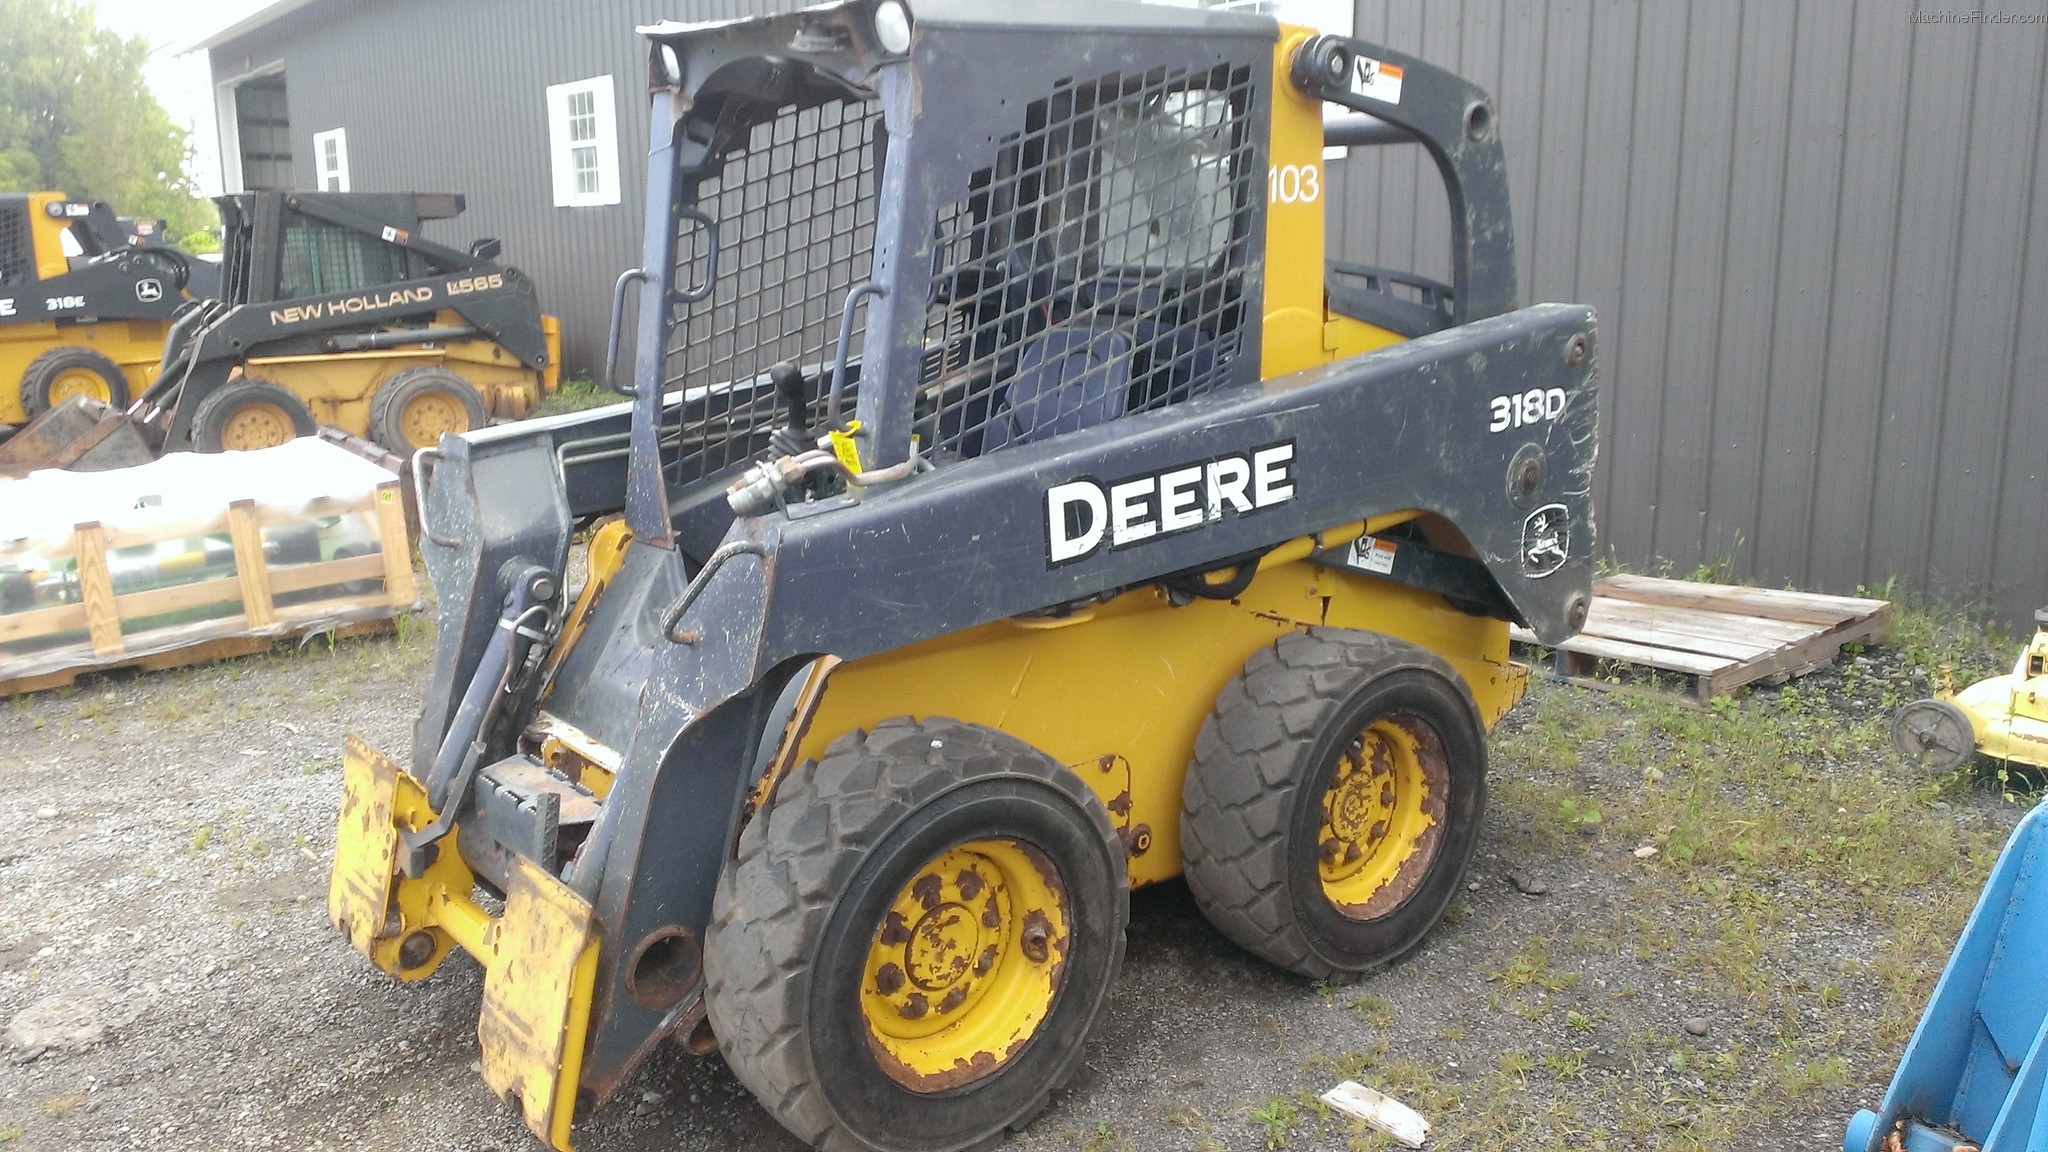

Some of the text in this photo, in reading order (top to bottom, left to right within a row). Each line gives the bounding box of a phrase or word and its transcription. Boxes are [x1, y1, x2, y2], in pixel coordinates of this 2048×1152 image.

[1268, 164, 1320, 204] 103
[270, 302, 322, 326] NEW
[327, 286, 433, 316] HOLLAND
[1489, 387, 1567, 433] 318D
[1047, 443, 1295, 563] DEERE
